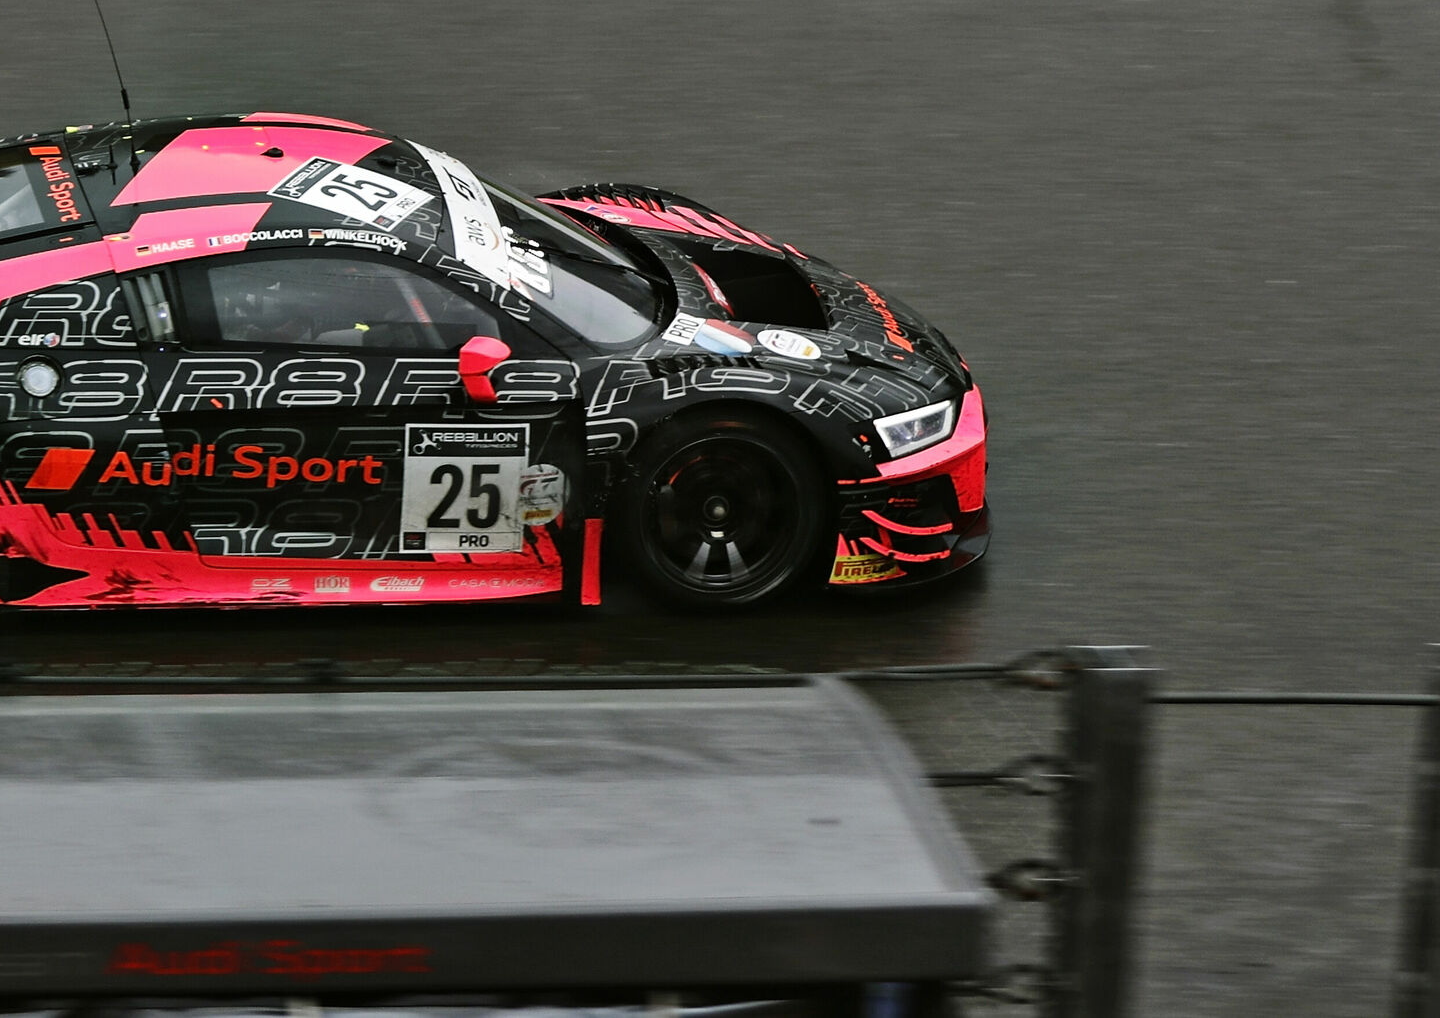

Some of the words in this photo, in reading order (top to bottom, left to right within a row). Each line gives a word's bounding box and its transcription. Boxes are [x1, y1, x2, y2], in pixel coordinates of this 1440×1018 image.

[40, 157, 71, 181] Audi
[47, 181, 82, 222] Sport
[321, 174, 398, 211] 25
[223, 229, 303, 245] BOCCOLACCI
[325, 229, 407, 251] WINKELHOCK
[464, 216, 486, 246] aws
[152, 239, 194, 253] HAASE
[669, 318, 700, 339] PRO
[18, 334, 44, 346] elf
[432, 432, 519, 442] REBELLION
[99, 444, 215, 486] Audi
[232, 445, 383, 488] Sport
[427, 464, 501, 529] 25
[459, 535, 489, 548] PRO
[370, 576, 425, 592] Eibach
